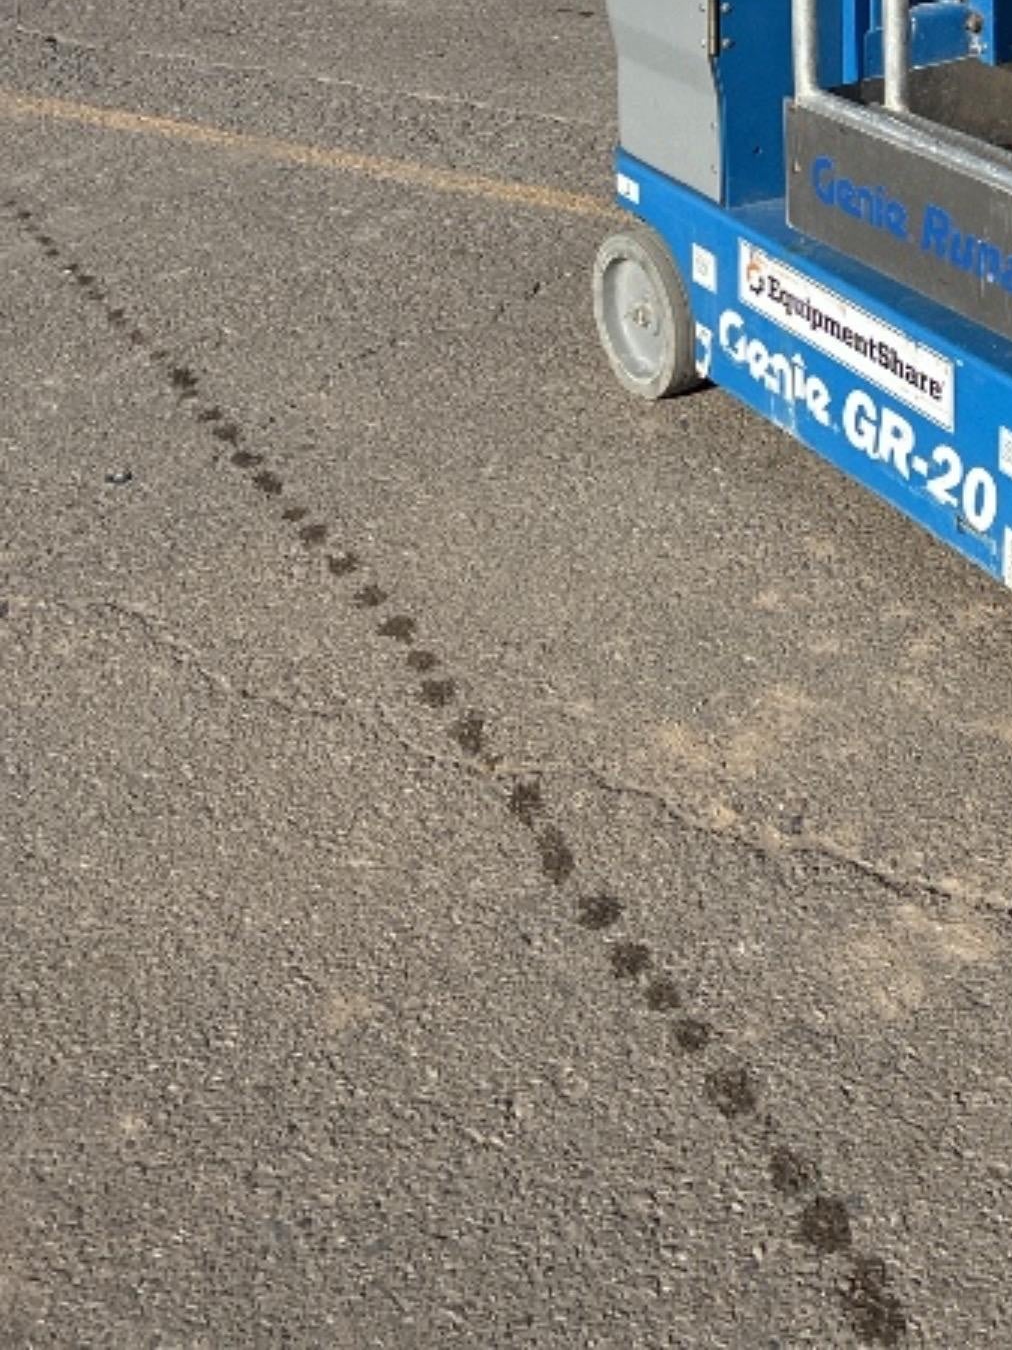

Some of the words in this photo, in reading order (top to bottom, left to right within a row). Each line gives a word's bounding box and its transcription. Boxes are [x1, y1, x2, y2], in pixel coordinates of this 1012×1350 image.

[810, 154, 909, 242] Genie
[766, 274, 945, 403] EquipmentShare
[718, 309, 835, 428] Genie
[842, 388, 998, 533] GR-20
